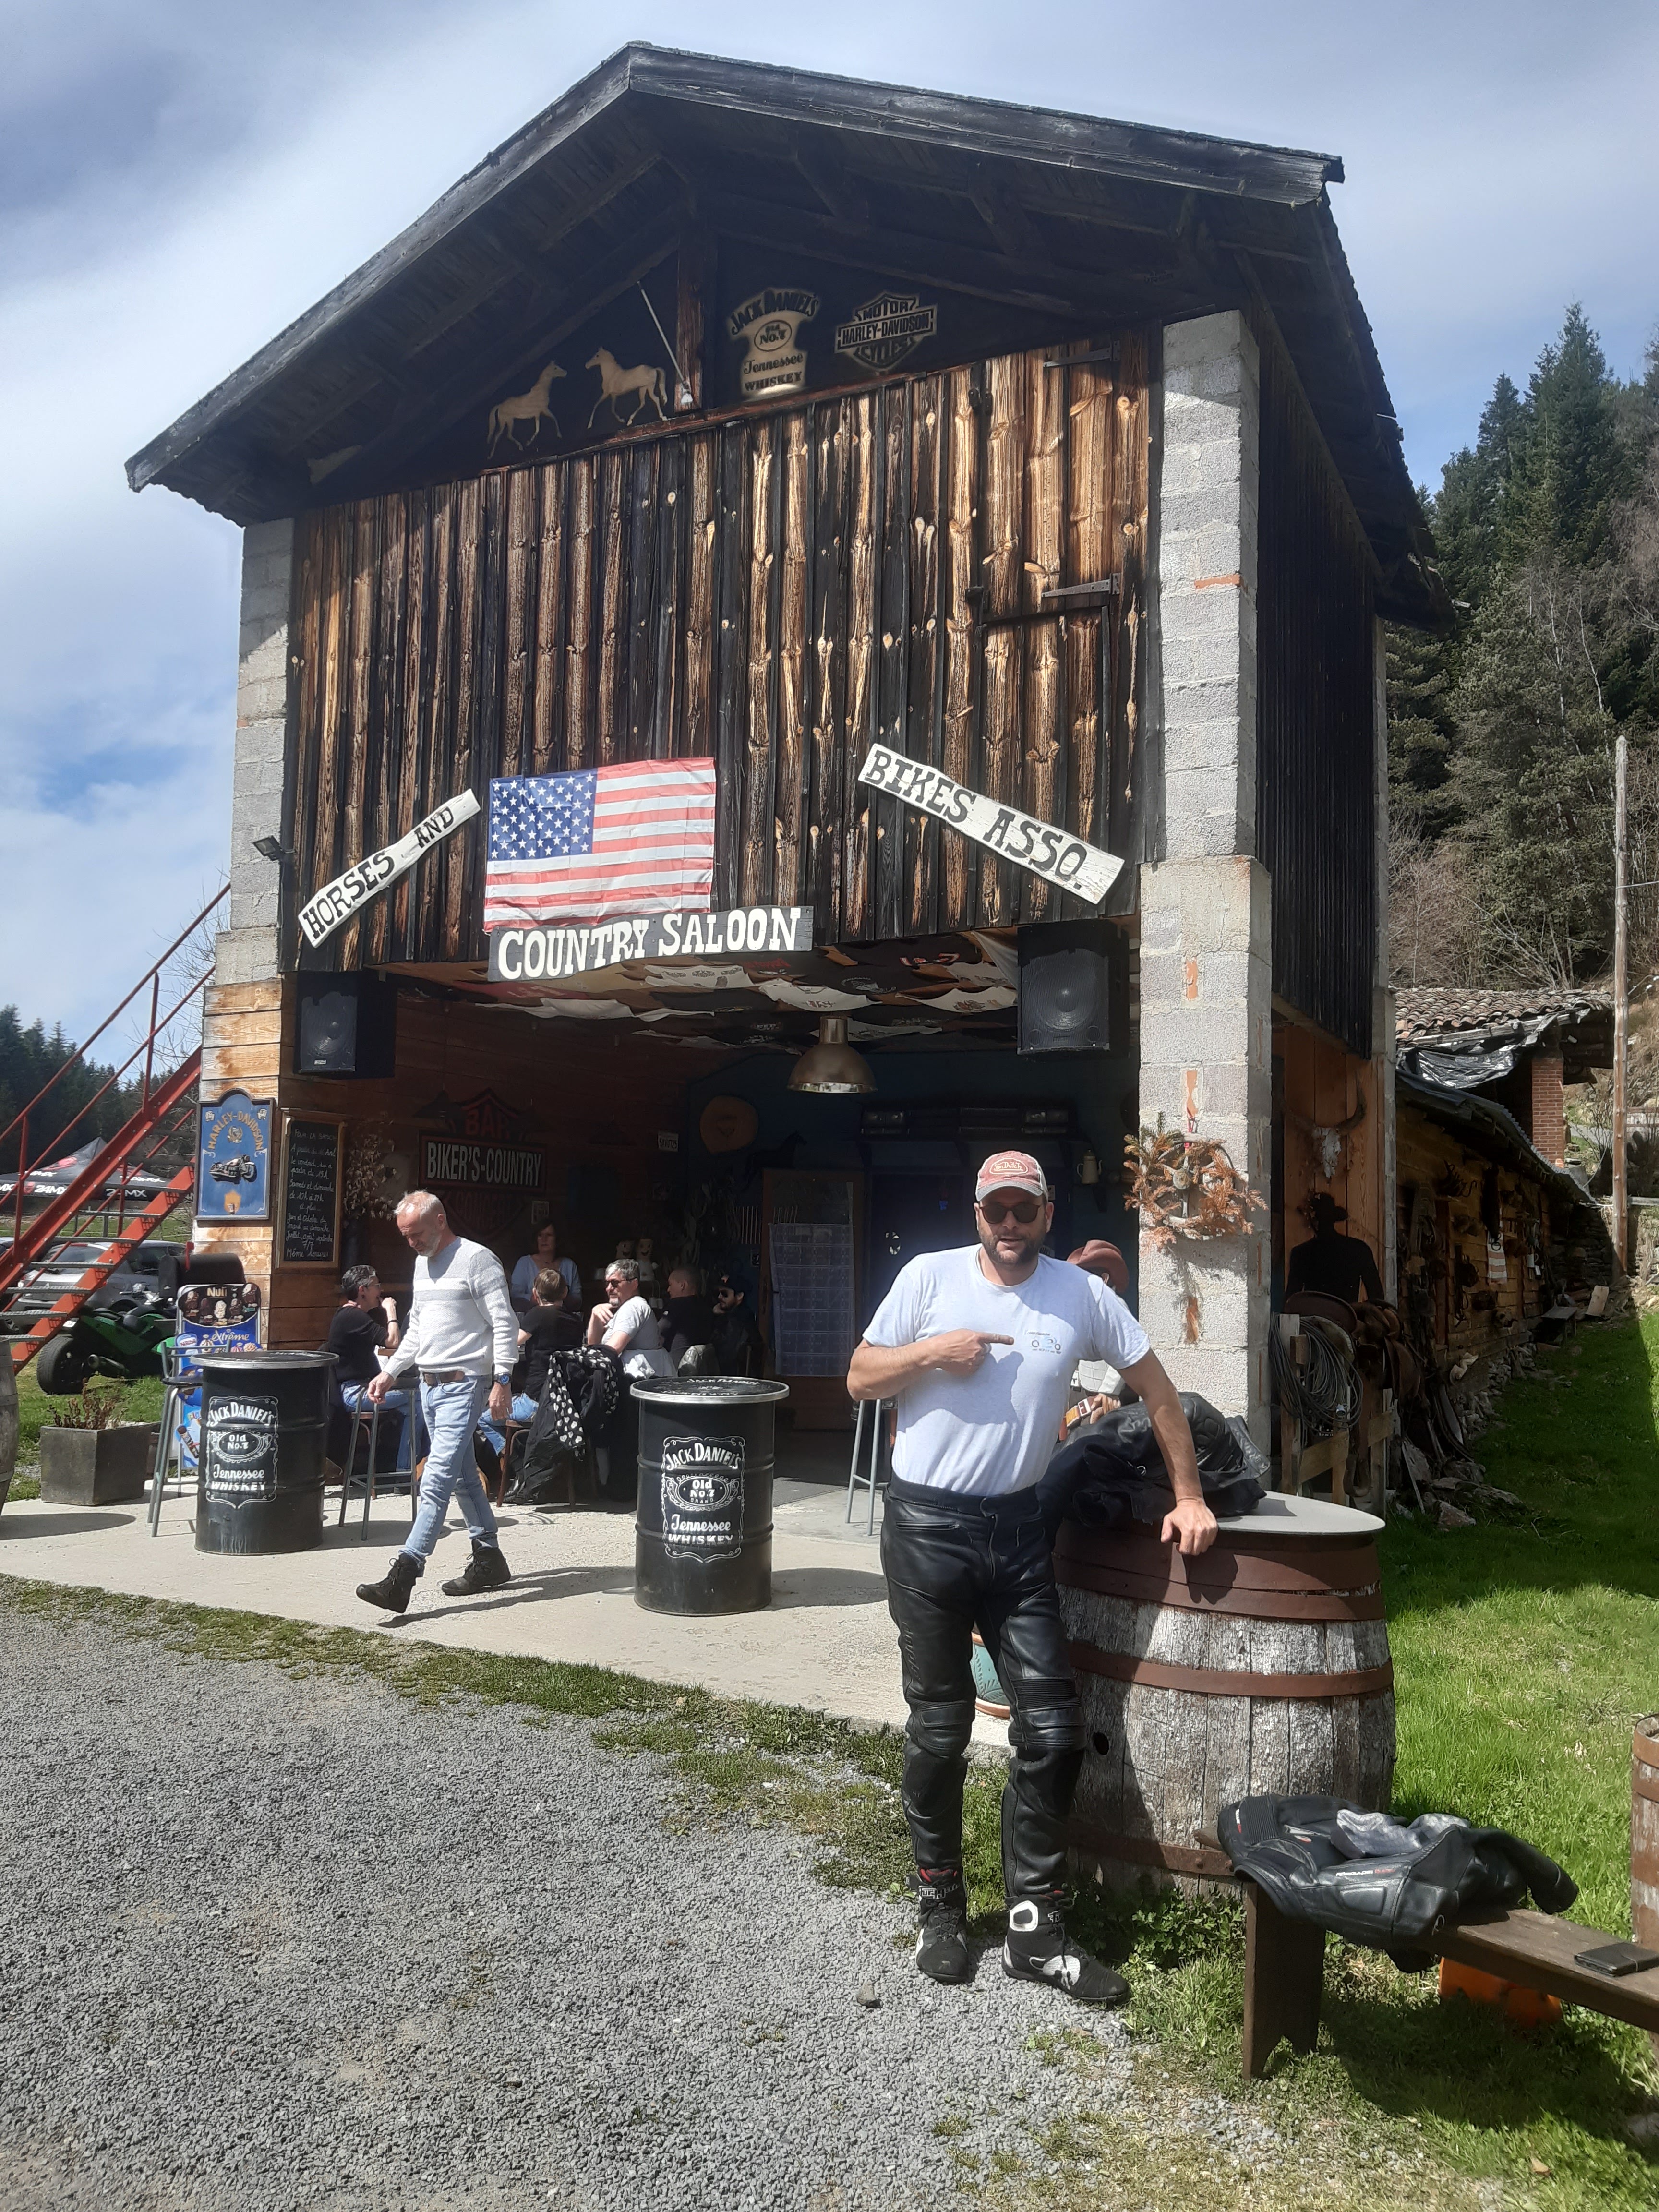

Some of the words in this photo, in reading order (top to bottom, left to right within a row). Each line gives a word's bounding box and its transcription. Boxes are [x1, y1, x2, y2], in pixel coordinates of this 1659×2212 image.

[732, 298, 765, 335] JACK
[863, 299, 908, 320] MOTOR
[842, 313, 929, 345] HARLEY-DAVIDSON
[744, 353, 803, 374] Tennessee
[745, 371, 802, 391] WHISKEY
[866, 750, 976, 823] BIKES
[303, 852, 394, 939] HORSES
[413, 807, 454, 848] AND
[499, 919, 649, 980] COUNTRY
[658, 908, 801, 956] SALOON
[208, 1111, 264, 1150] HARLEY-DAVIDSON
[428, 1142, 541, 1186] BIKER'S-COUNTRY
[1004, 1162, 1022, 1170] Dutch
[106, 1189, 147, 1197] 2MX
[209, 1405, 230, 1427] JACK
[230, 1401, 275, 1425] DANIEL'S
[665, 1449, 695, 1470] JACK
[695, 1443, 741, 1469] DANIEL'S
[213, 1464, 264, 1479] Tennessee
[211, 1481, 266, 1491] WHISKEY
[690, 1489, 715, 1497] No.7
[692, 1480, 712, 1489] Old
[671, 1514, 731, 1532] Tennessee
[669, 1534, 733, 1544] WHISKEY
